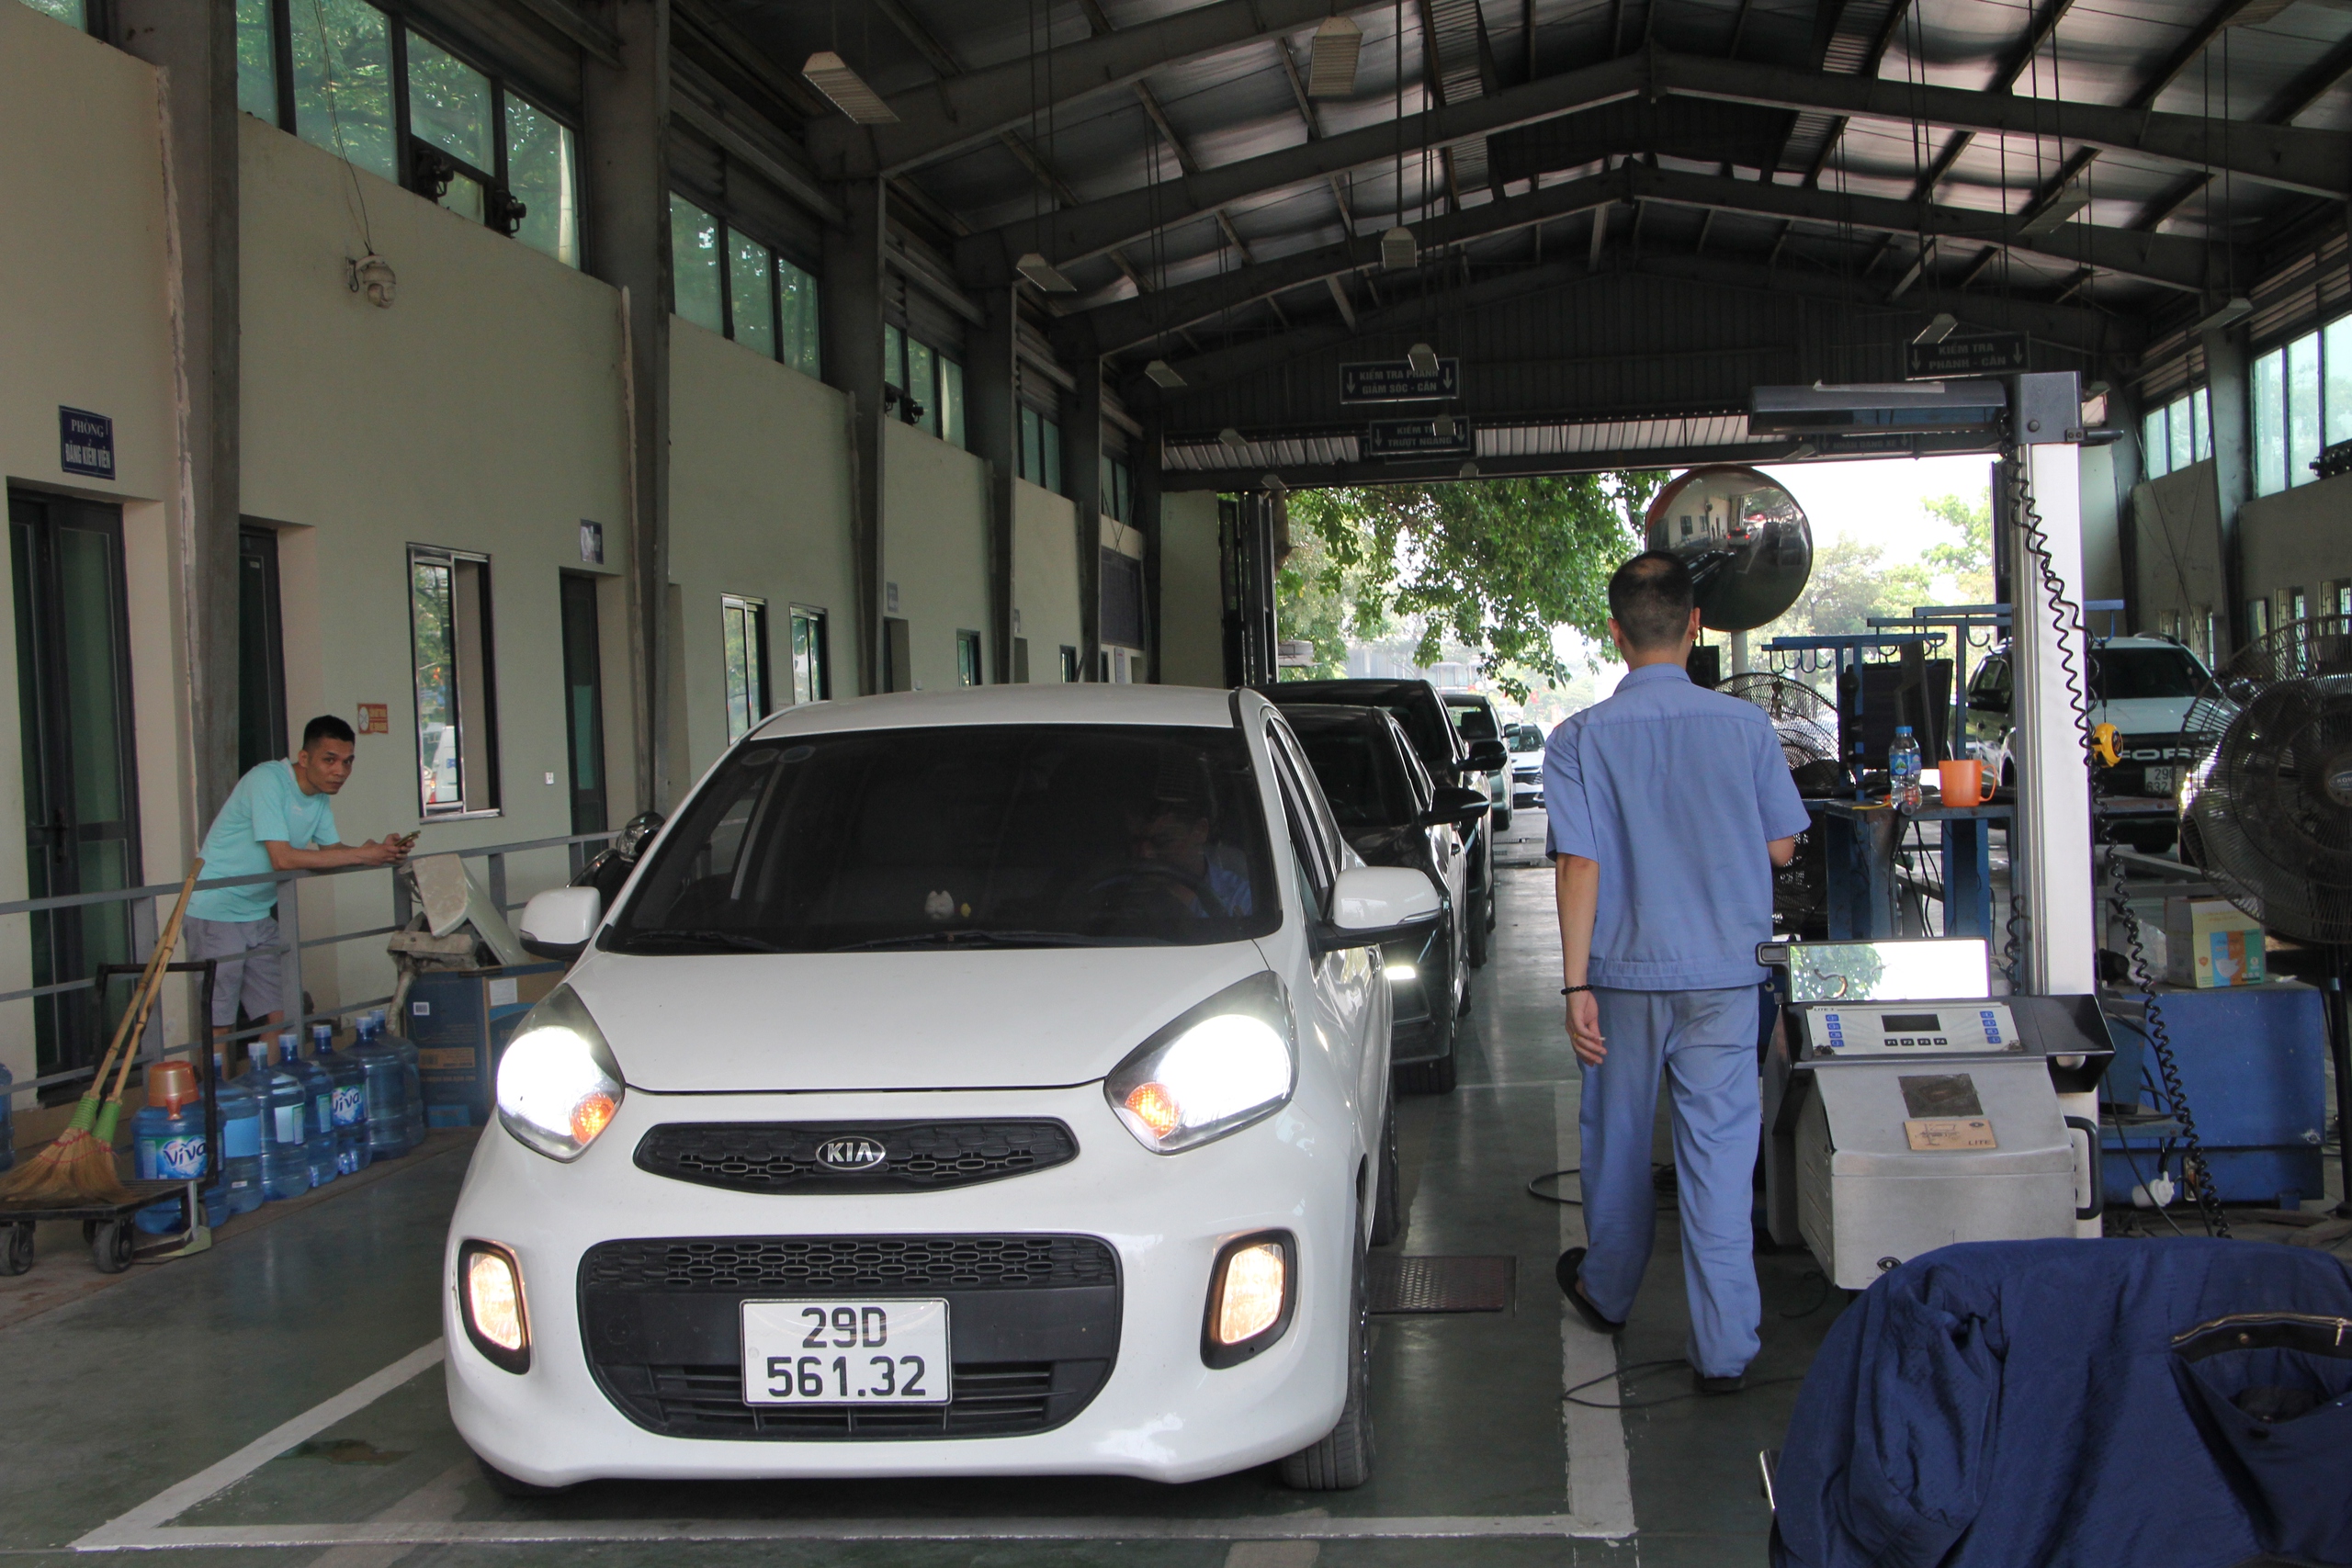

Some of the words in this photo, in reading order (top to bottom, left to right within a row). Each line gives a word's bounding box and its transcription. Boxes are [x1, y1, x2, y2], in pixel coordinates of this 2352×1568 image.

[1973, 343, 1995, 354] TRA
[1928, 357, 1970, 369] PHANH
[1385, 369, 1404, 378] TRA
[71, 418, 104, 438] PHÒNG
[827, 1142, 874, 1163] KIA
[801, 1306, 888, 1348] 29D
[766, 1354, 926, 1397] 561.32
